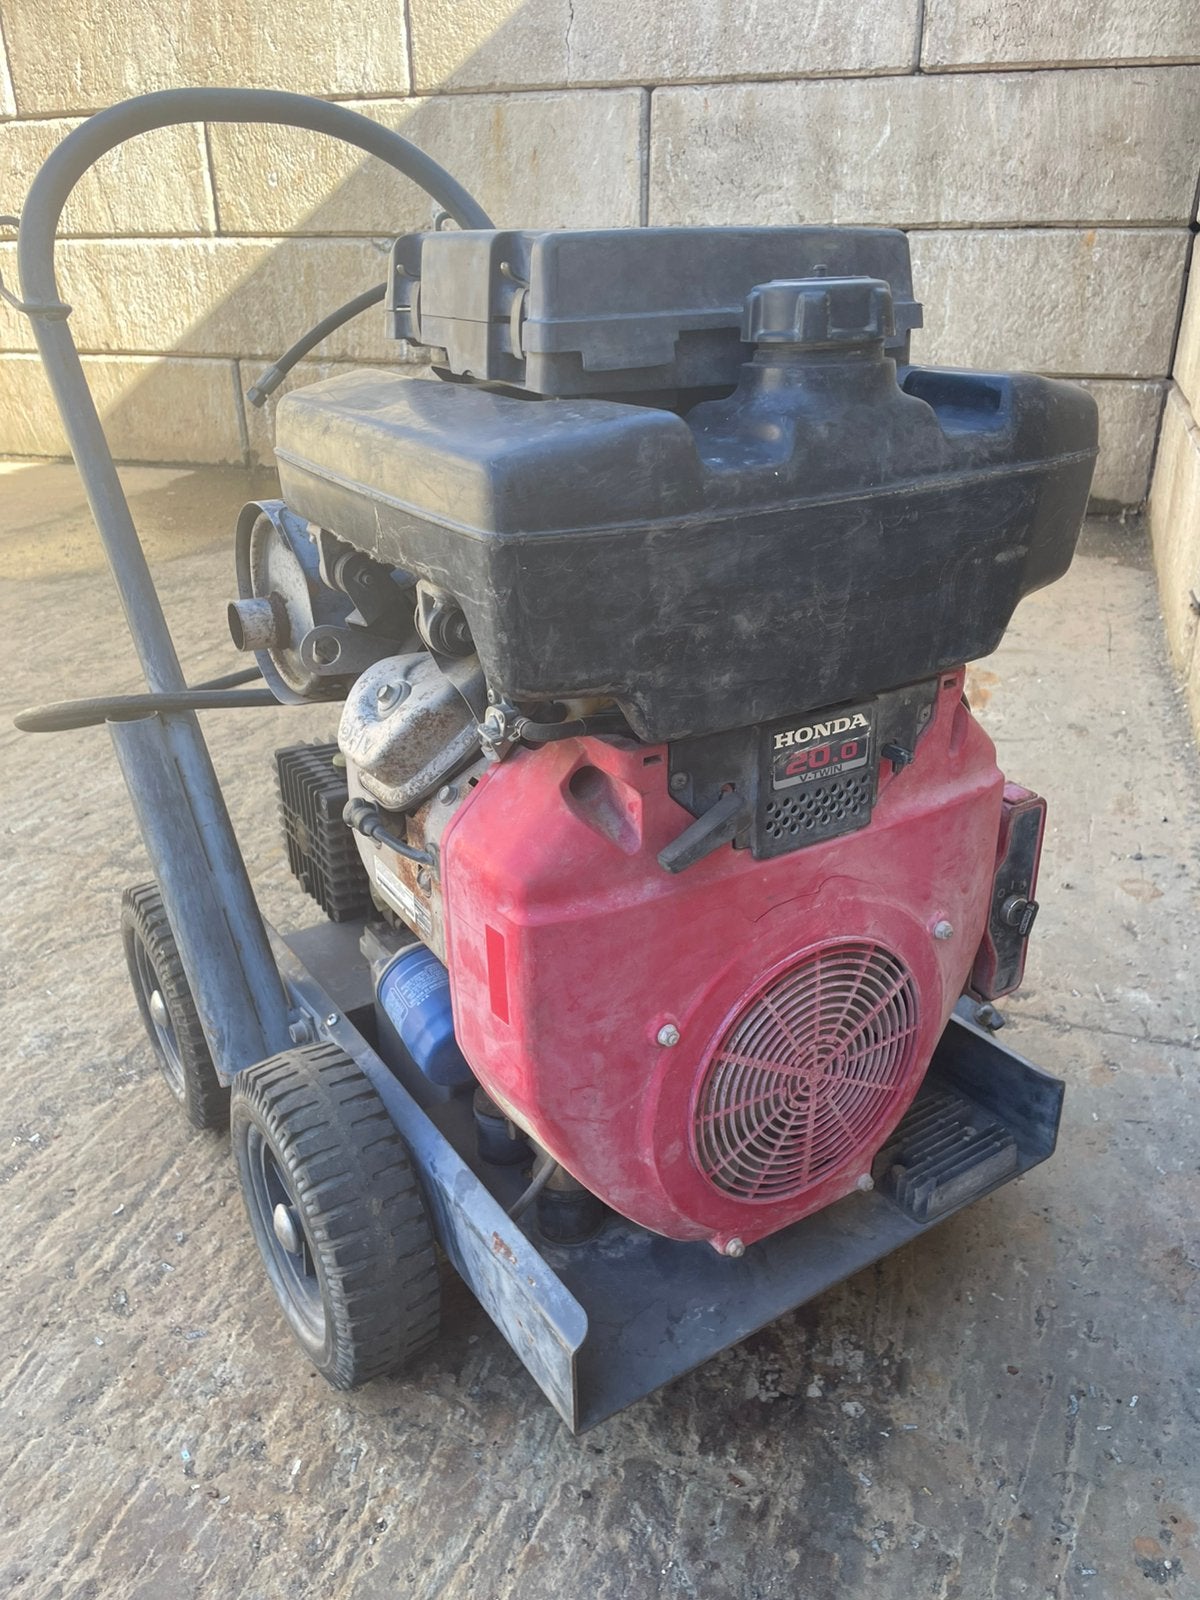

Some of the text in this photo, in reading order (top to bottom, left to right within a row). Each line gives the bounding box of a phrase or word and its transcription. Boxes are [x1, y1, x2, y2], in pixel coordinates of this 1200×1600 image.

[774, 713, 869, 749] HONDA
[785, 741, 858, 776] 20.0
[800, 764, 842, 782] V-TWIN
